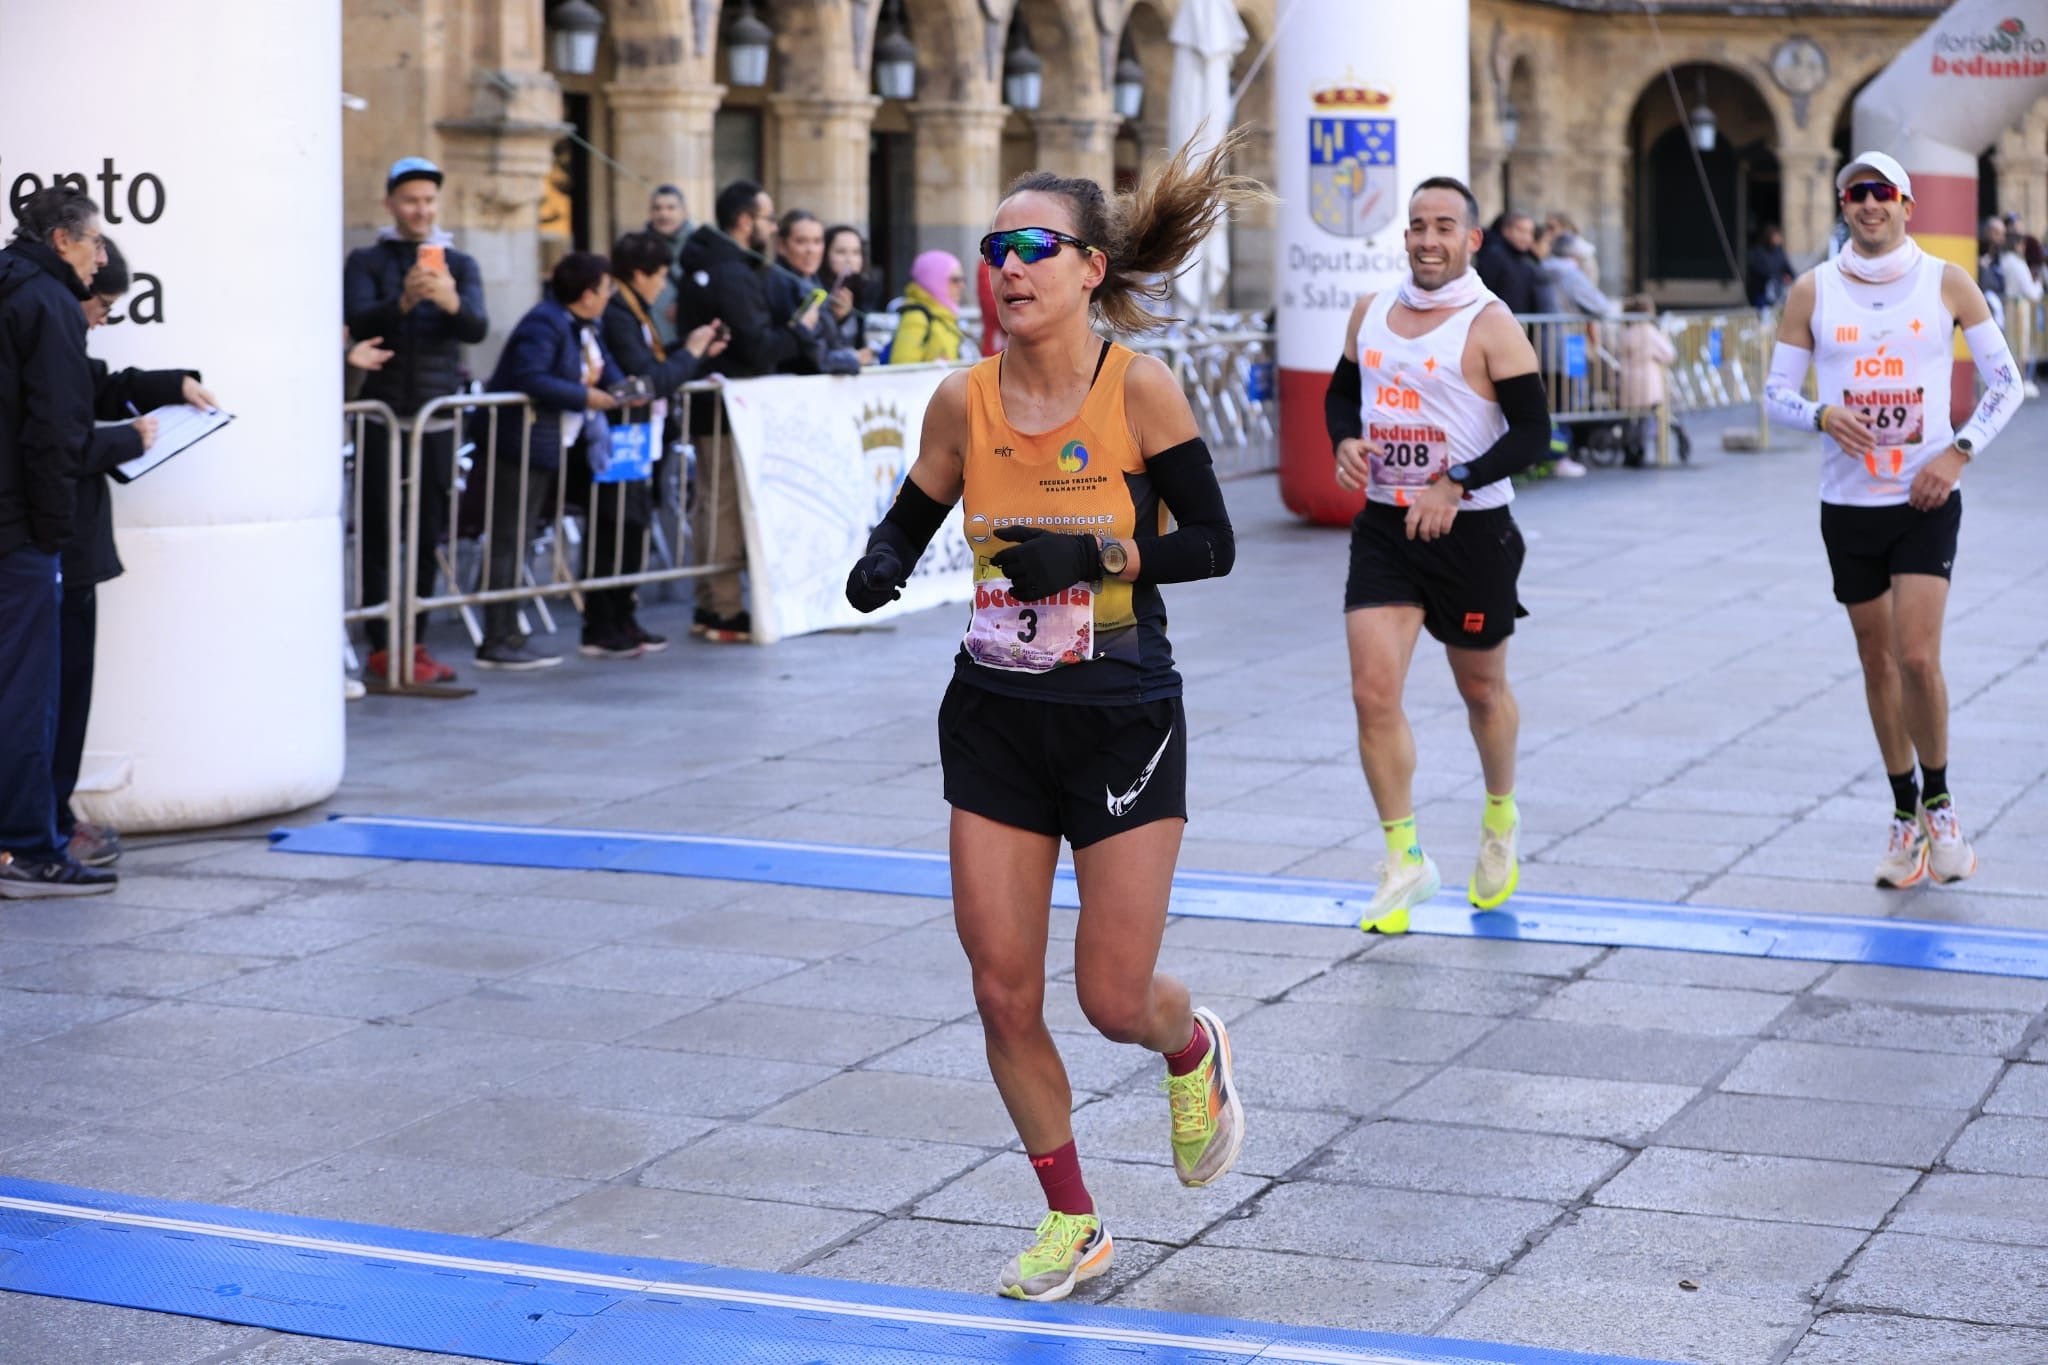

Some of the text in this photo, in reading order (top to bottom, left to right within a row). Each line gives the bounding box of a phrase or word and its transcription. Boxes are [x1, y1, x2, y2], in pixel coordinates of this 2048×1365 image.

[105, 272, 165, 325] a
[1369, 423, 1446, 442] bedunia
[1383, 443, 1429, 467] 208
[993, 517, 1033, 527] ESTER
[1017, 608, 1038, 644] 3
